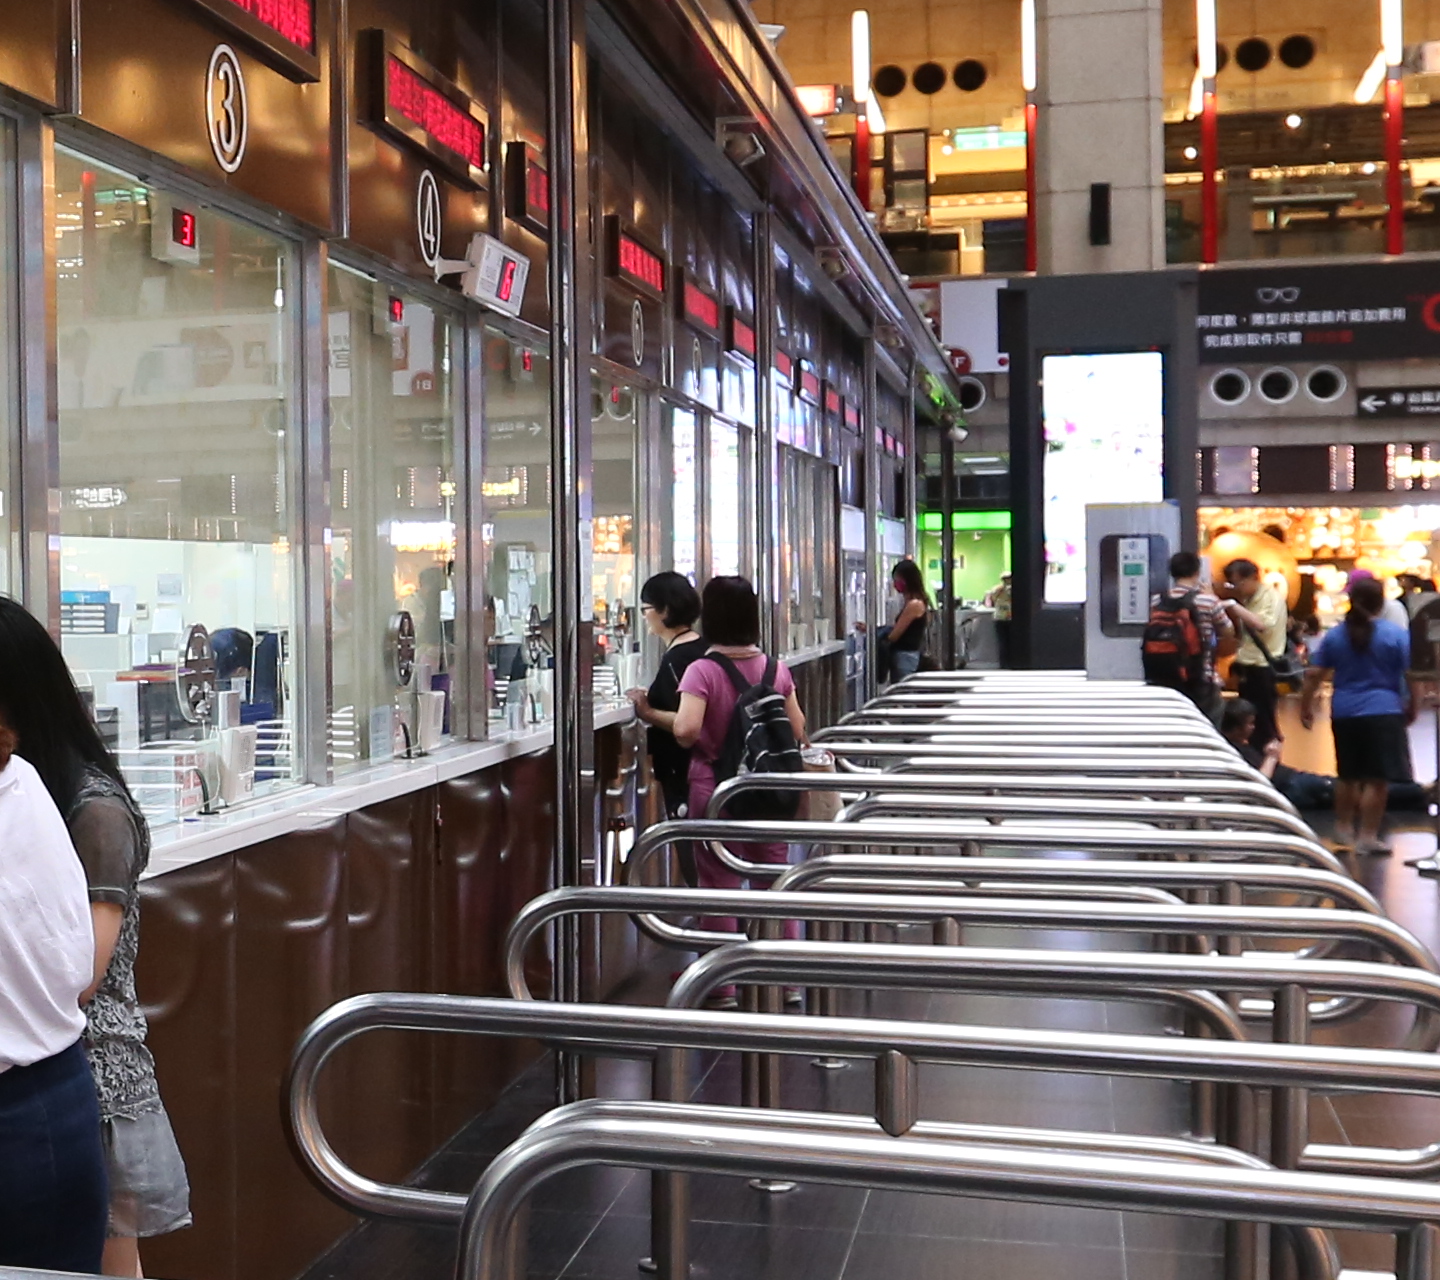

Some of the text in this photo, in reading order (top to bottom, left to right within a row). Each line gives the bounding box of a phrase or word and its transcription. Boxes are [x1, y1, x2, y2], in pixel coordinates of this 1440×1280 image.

[216, 60, 233, 153] 3
[181, 213, 193, 245] 3
[424, 184, 436, 254] 4
